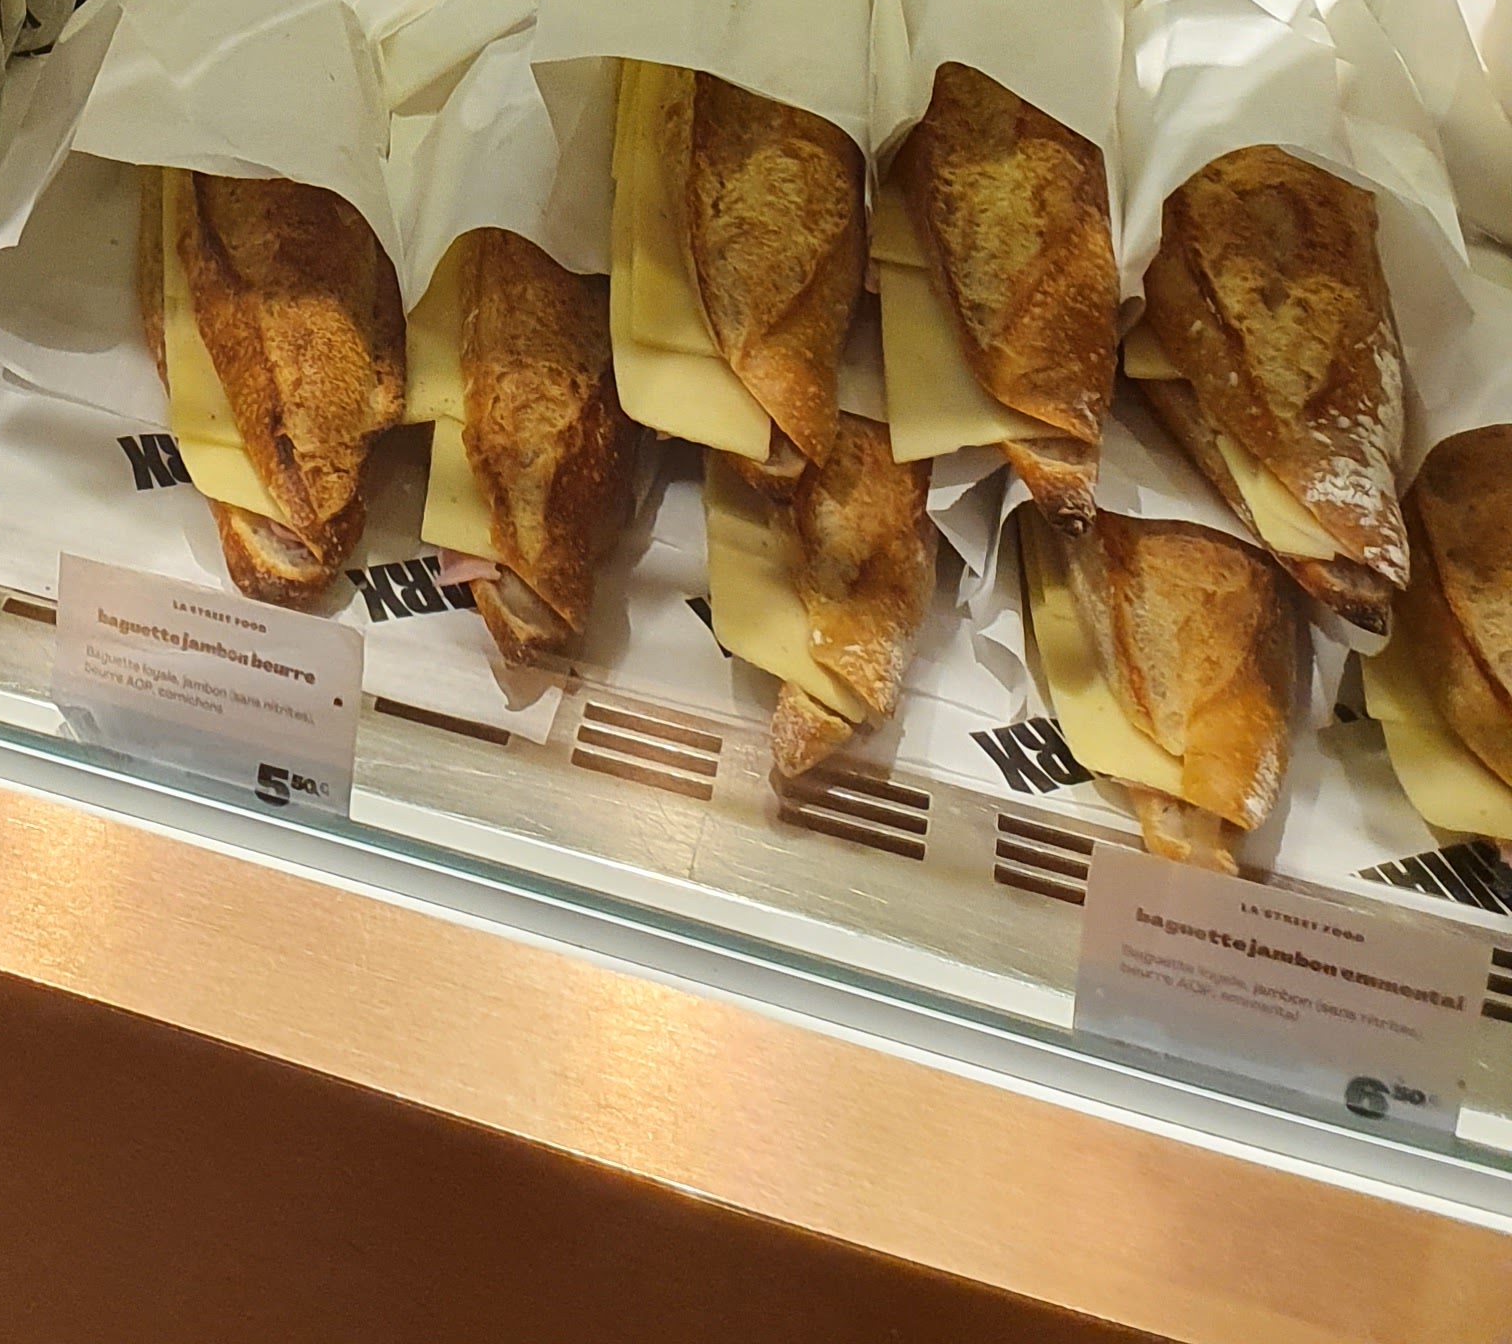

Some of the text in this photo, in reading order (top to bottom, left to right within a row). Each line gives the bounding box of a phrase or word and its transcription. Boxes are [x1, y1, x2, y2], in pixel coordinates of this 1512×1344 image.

[97, 608, 317, 686] baguette jambon beurre
[1135, 906, 1466, 1012] baguette jambon emmental
